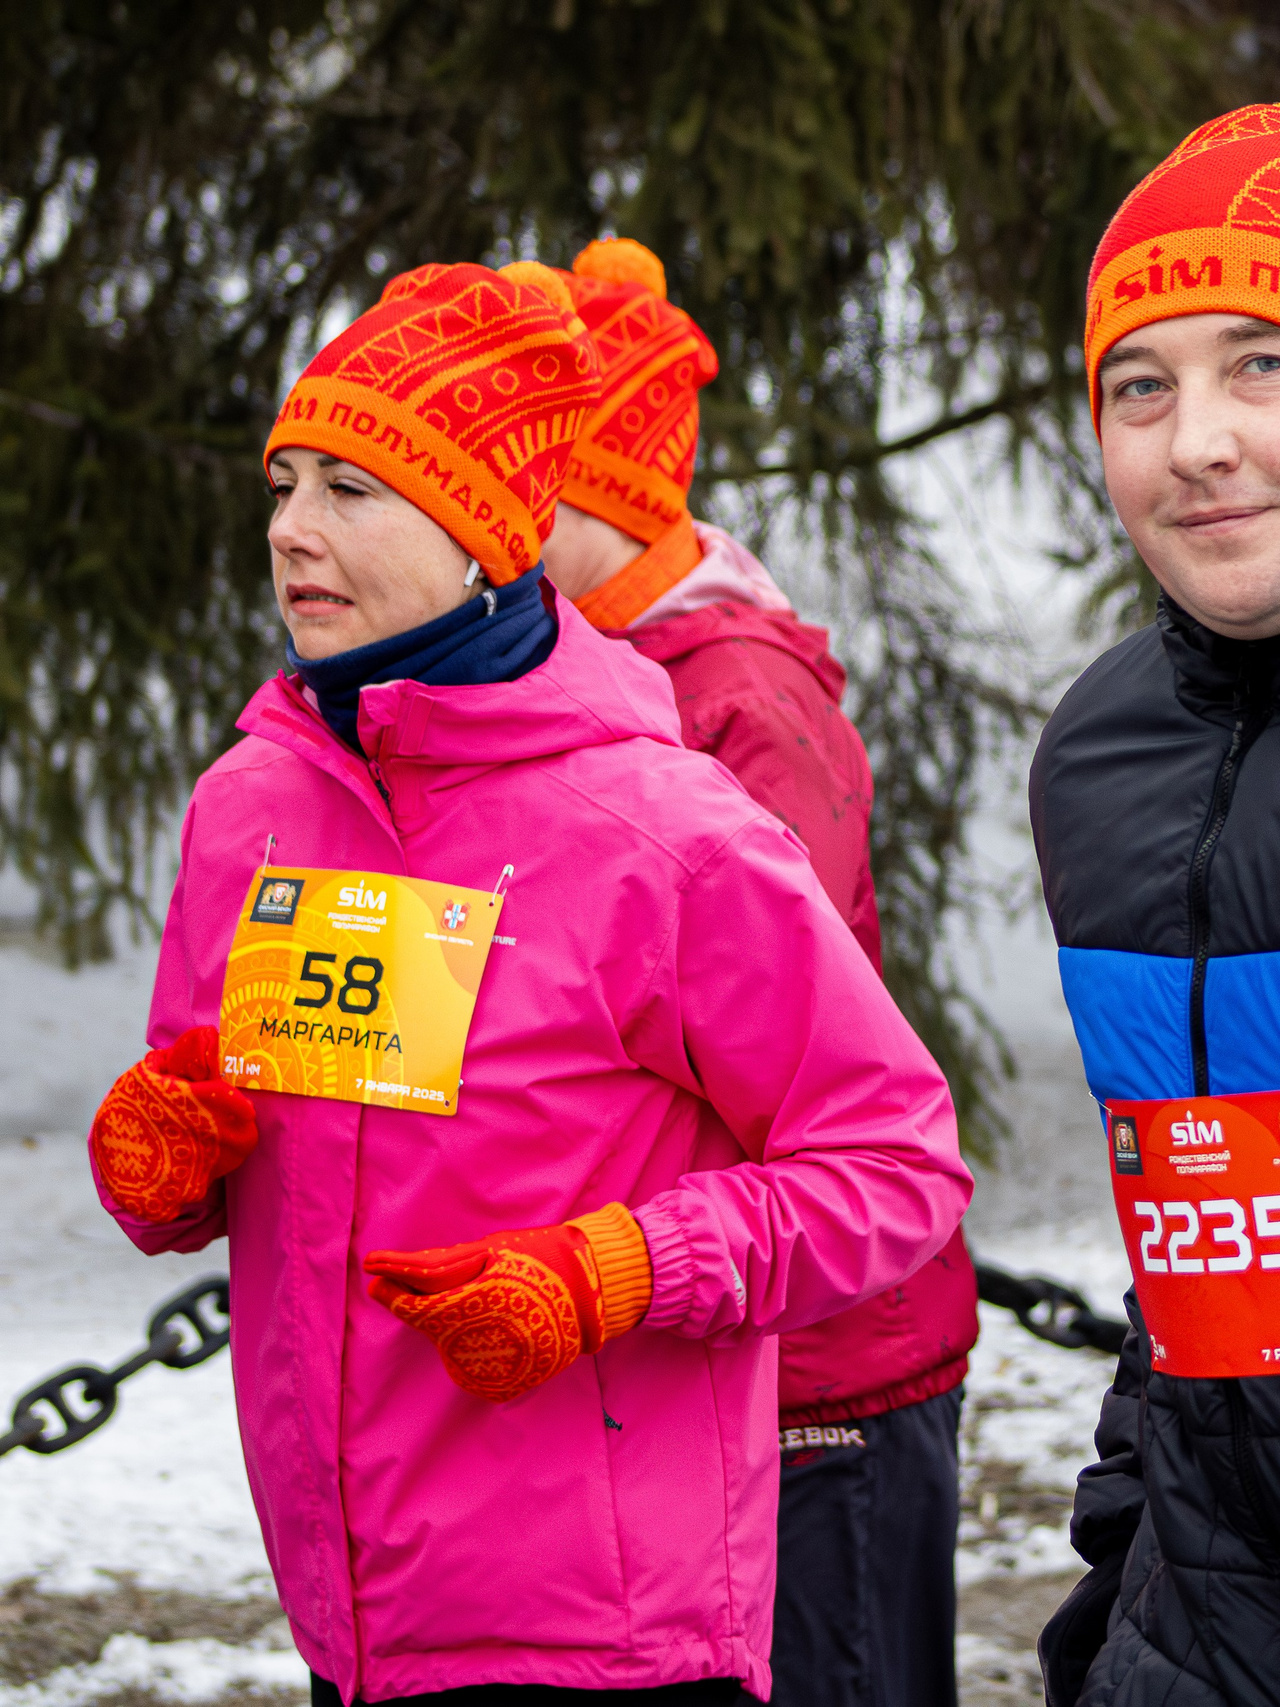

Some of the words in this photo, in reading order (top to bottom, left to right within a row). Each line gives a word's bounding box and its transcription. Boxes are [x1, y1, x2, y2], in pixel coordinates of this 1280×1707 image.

[294, 950, 384, 1016] 58
[259, 1016, 403, 1055] МАРГАРИТА
[355, 1078, 364, 1089] 7
[365, 1080, 411, 1097] ЯНВАРЯ
[412, 1087, 445, 1102] 2025
[1168, 1149, 1231, 1165] РОЖДЕСТВЕНСКИЙ
[1176, 1163, 1228, 1174] ПОЛУМАРАФОН
[1261, 1348, 1271, 1361] 7
